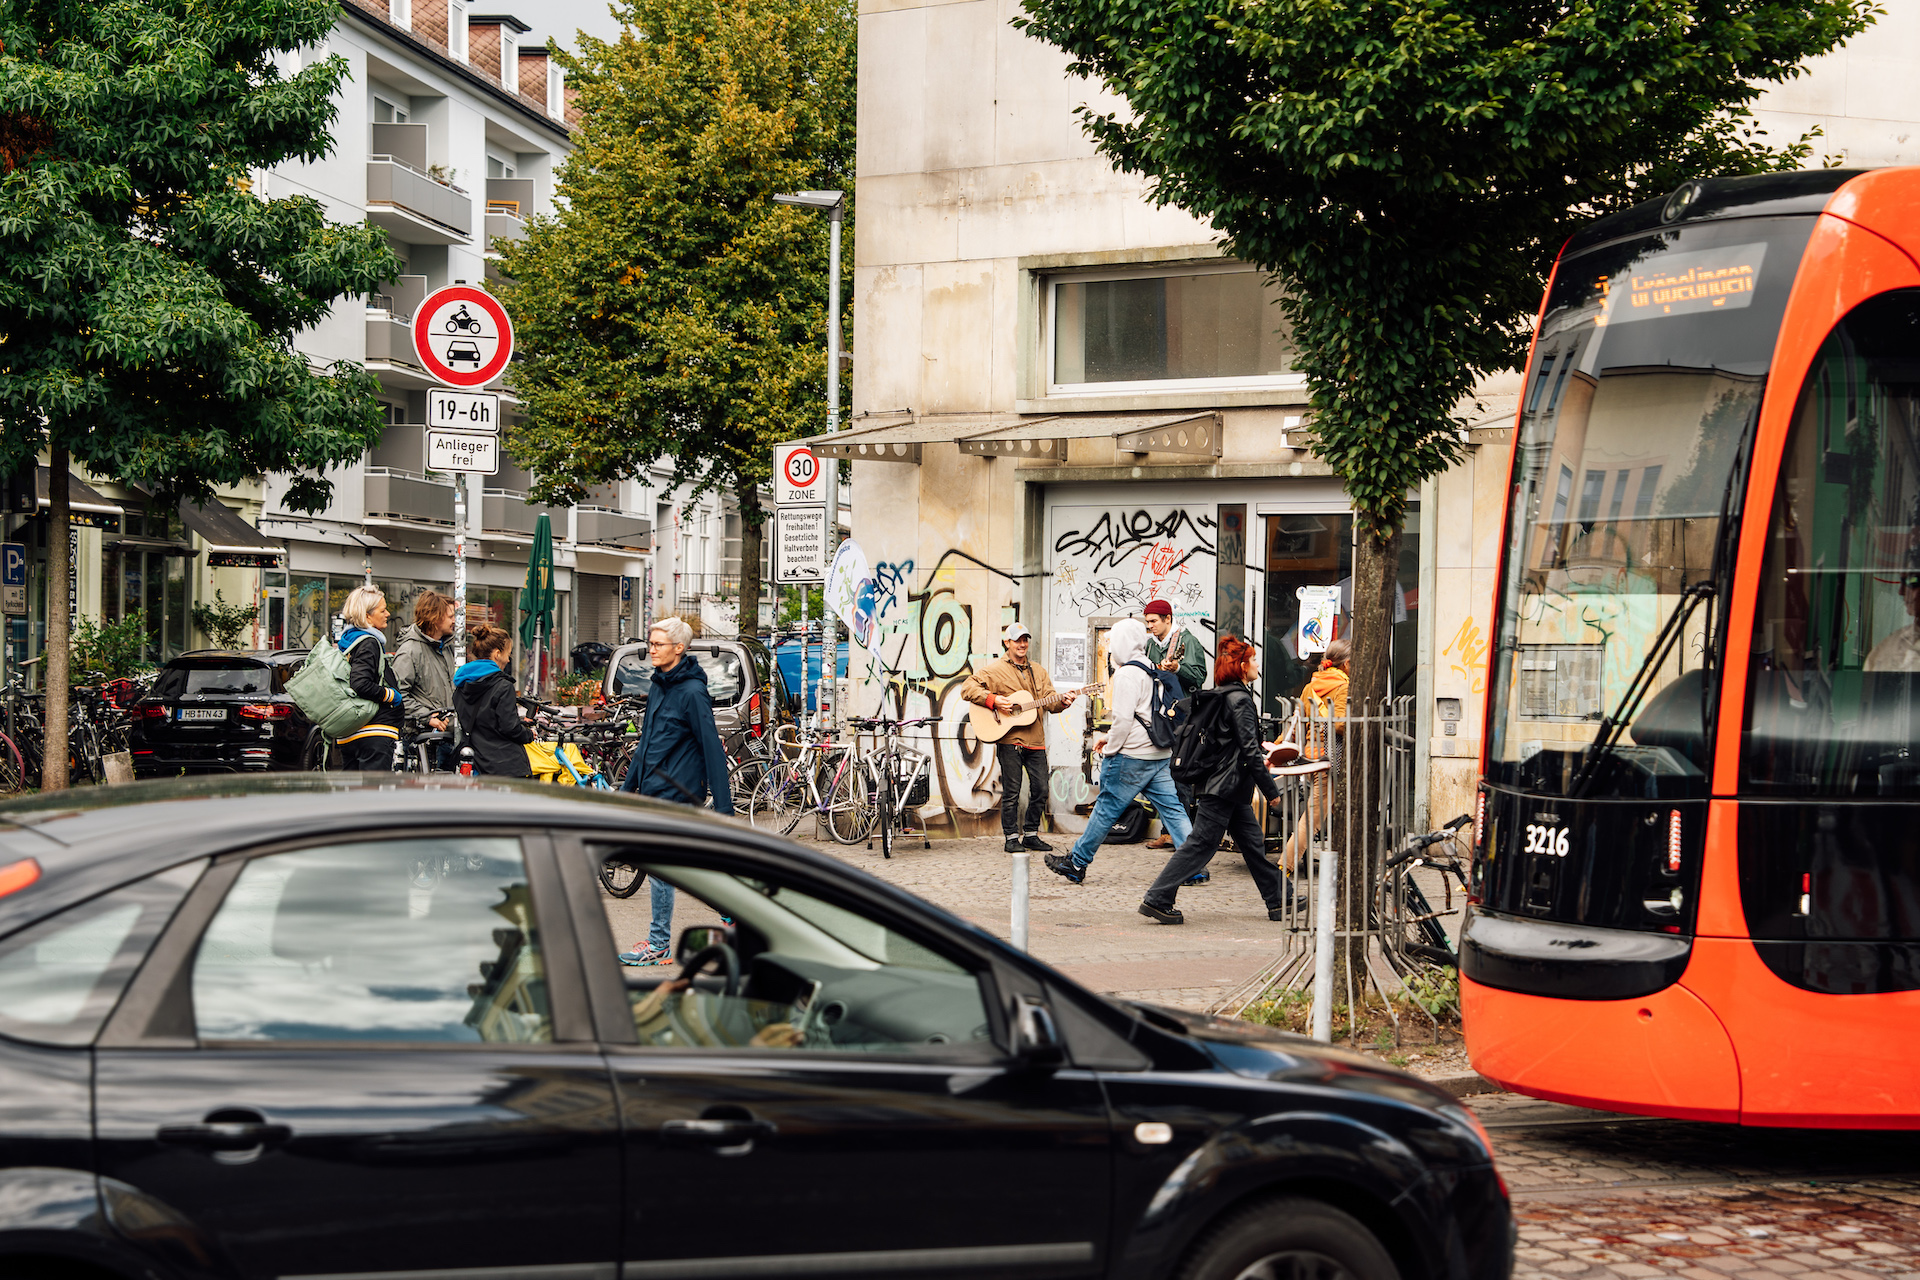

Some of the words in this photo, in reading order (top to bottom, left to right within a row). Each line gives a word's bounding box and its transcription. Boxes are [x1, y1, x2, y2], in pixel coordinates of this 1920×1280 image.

[438, 400, 490, 422] 19-6h
[436, 438, 489, 454] Anlieger
[452, 454, 474, 465] frei
[791, 459, 812, 477] 30
[788, 489, 816, 500] ZONE
[780, 512, 823, 522] Rettungswege
[785, 522, 818, 531] freihalten!
[784, 533, 819, 542] Gesetzliche
[784, 544, 819, 552] Haltverbote
[786, 554, 817, 563] beachten!
[7, 549, 20, 580] P
[185, 710, 196, 718] HB
[202, 710, 212, 718] TN
[212, 710, 223, 718] 43
[1524, 823, 1570, 858] 3216
